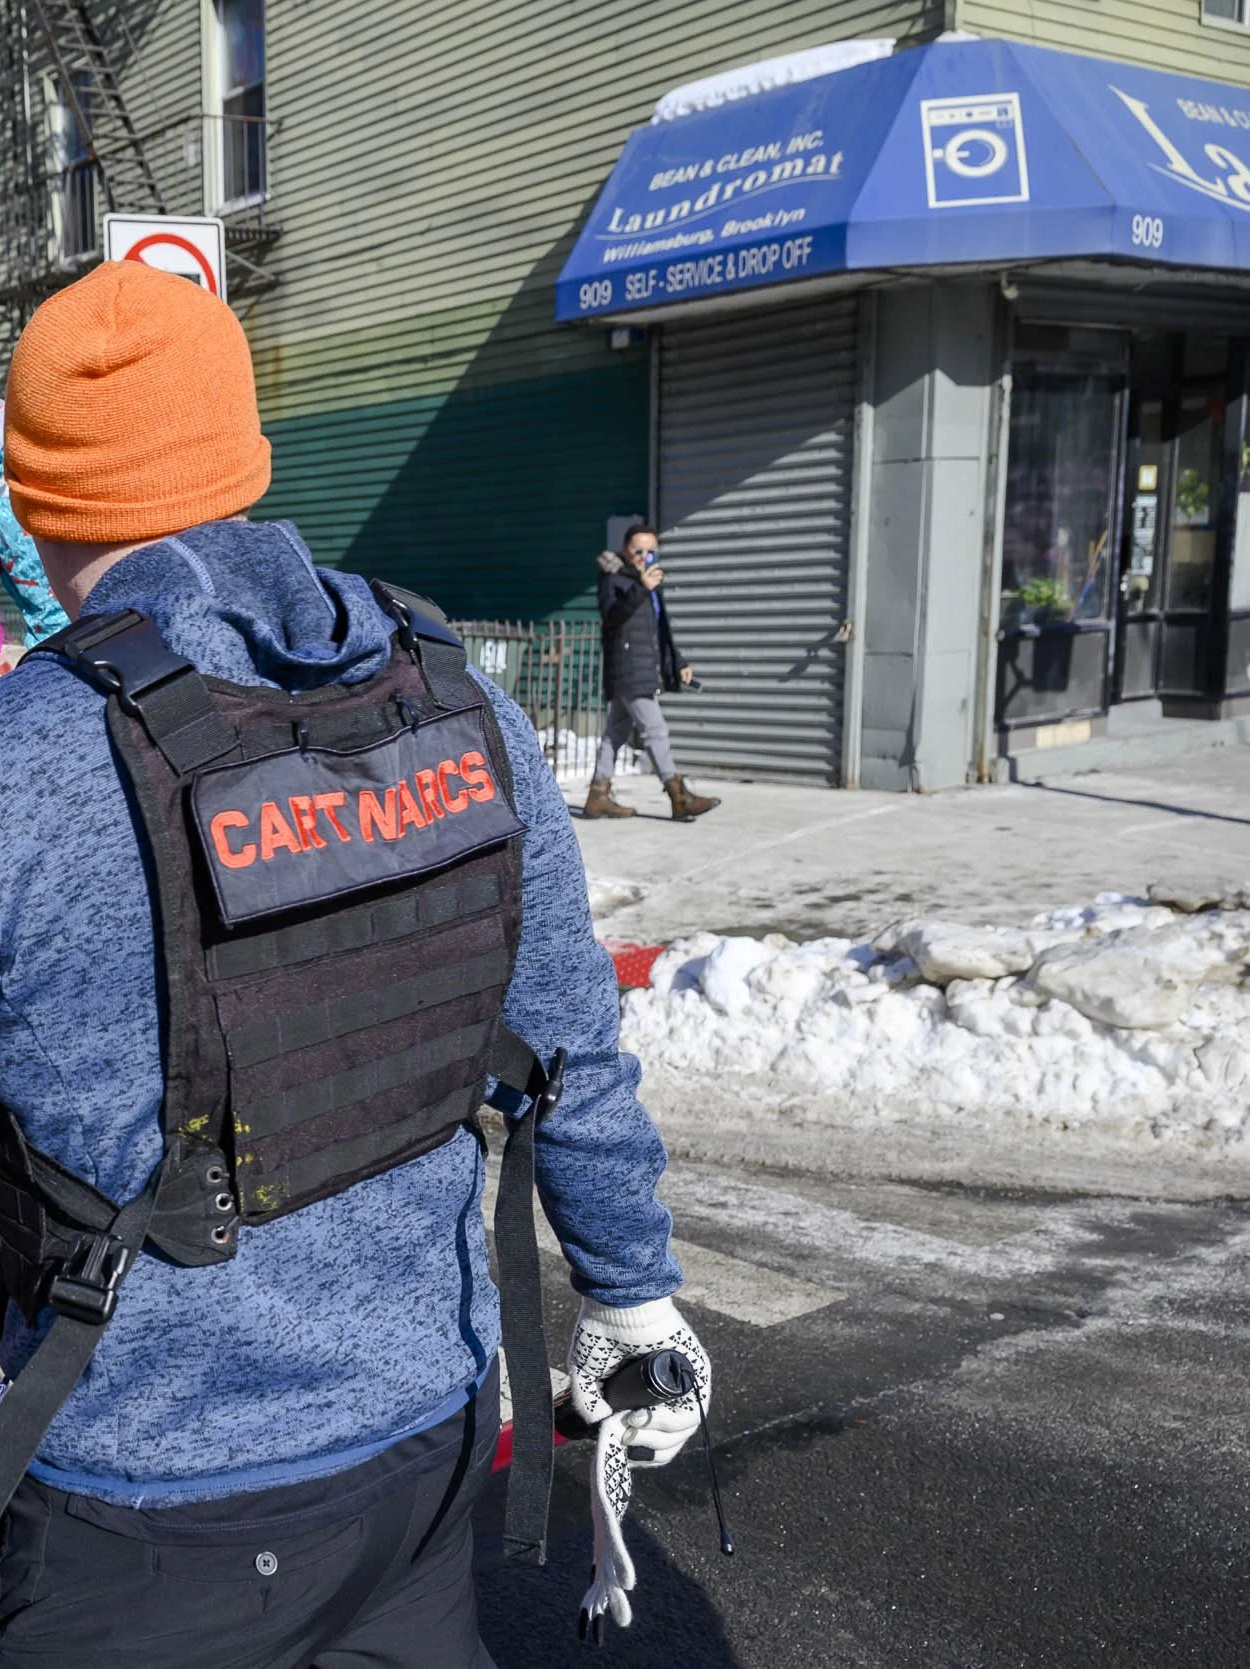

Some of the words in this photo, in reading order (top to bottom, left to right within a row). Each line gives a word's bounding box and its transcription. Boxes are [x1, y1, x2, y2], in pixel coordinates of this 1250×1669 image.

[606, 151, 843, 233] Laundromat
[649, 164, 698, 191] BEAN
[699, 159, 714, 178] &
[786, 131, 825, 153] INC.
[720, 207, 806, 238] Brooklyn
[1131, 214, 1164, 248] 909
[579, 279, 612, 310] 909
[725, 252, 737, 280] &
[738, 242, 780, 278] DROP
[782, 236, 814, 269] OFF
[209, 791, 352, 870] CART
[358, 750, 497, 843] NARCS
